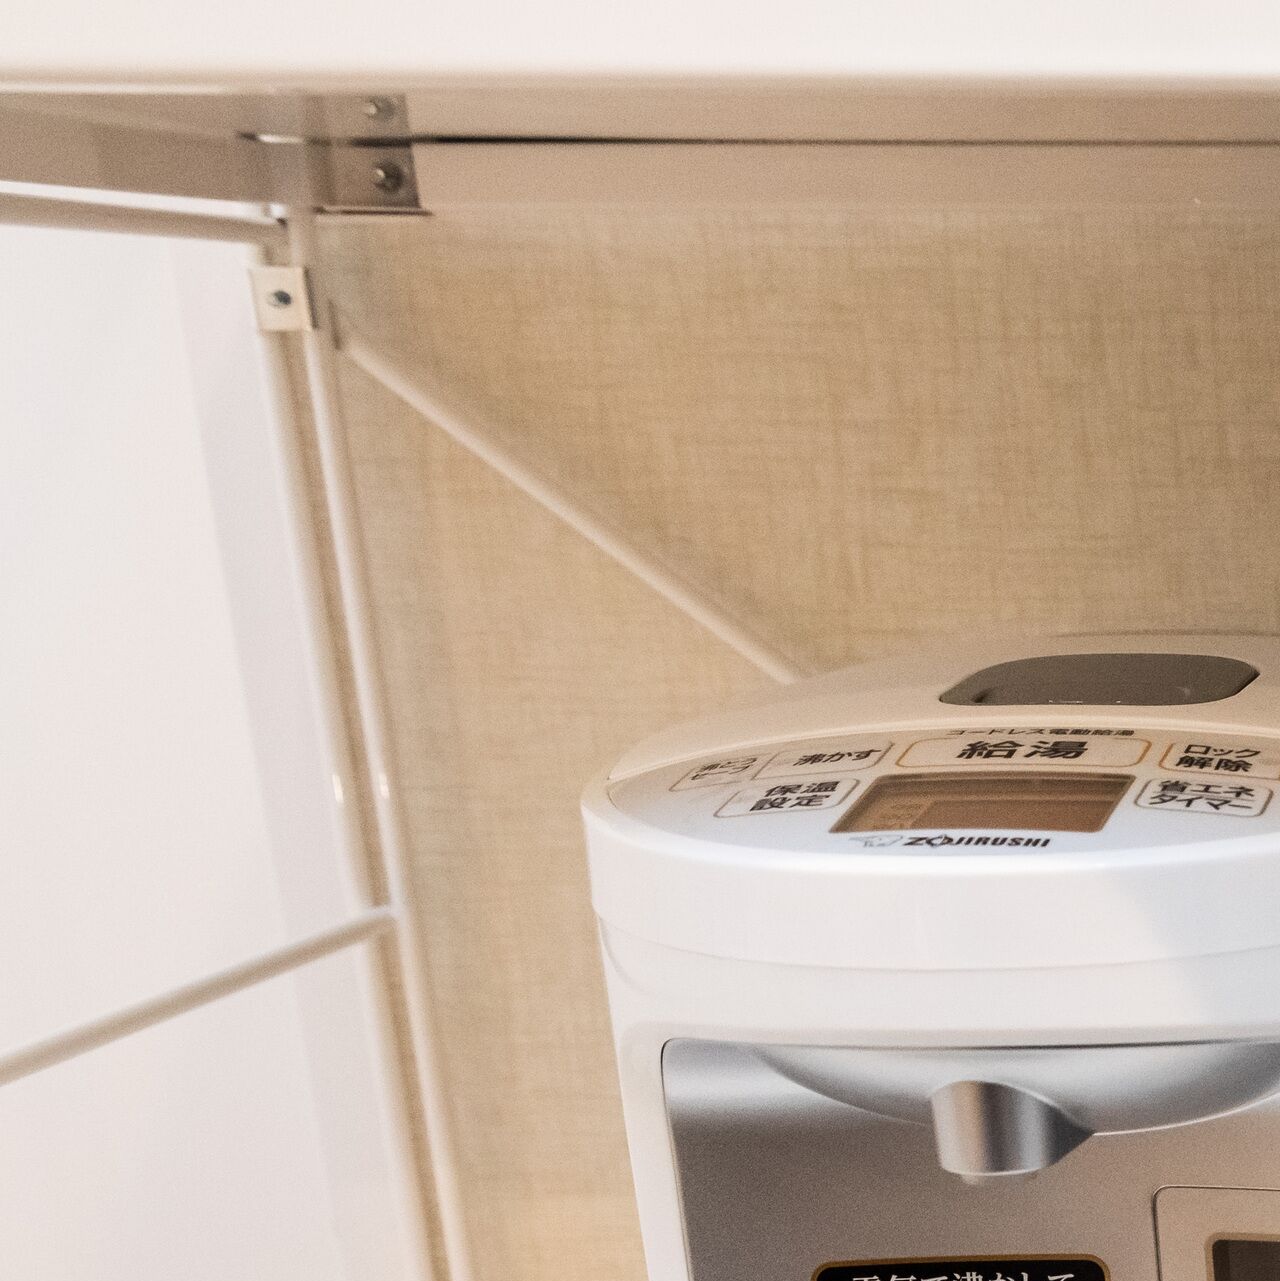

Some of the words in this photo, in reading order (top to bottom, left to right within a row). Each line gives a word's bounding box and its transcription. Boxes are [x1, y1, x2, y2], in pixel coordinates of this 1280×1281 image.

[793, 748, 882, 767] 沸かす
[956, 740, 1088, 759] 給湯
[1183, 744, 1261, 758] ロック
[1175, 755, 1253, 773] 解除
[764, 781, 841, 797] 保温
[1158, 780, 1256, 798] 省エネ
[749, 794, 831, 812] 設定
[1148, 794, 1253, 811] タイマー
[903, 834, 1051, 848] ZOJIRUSHI
